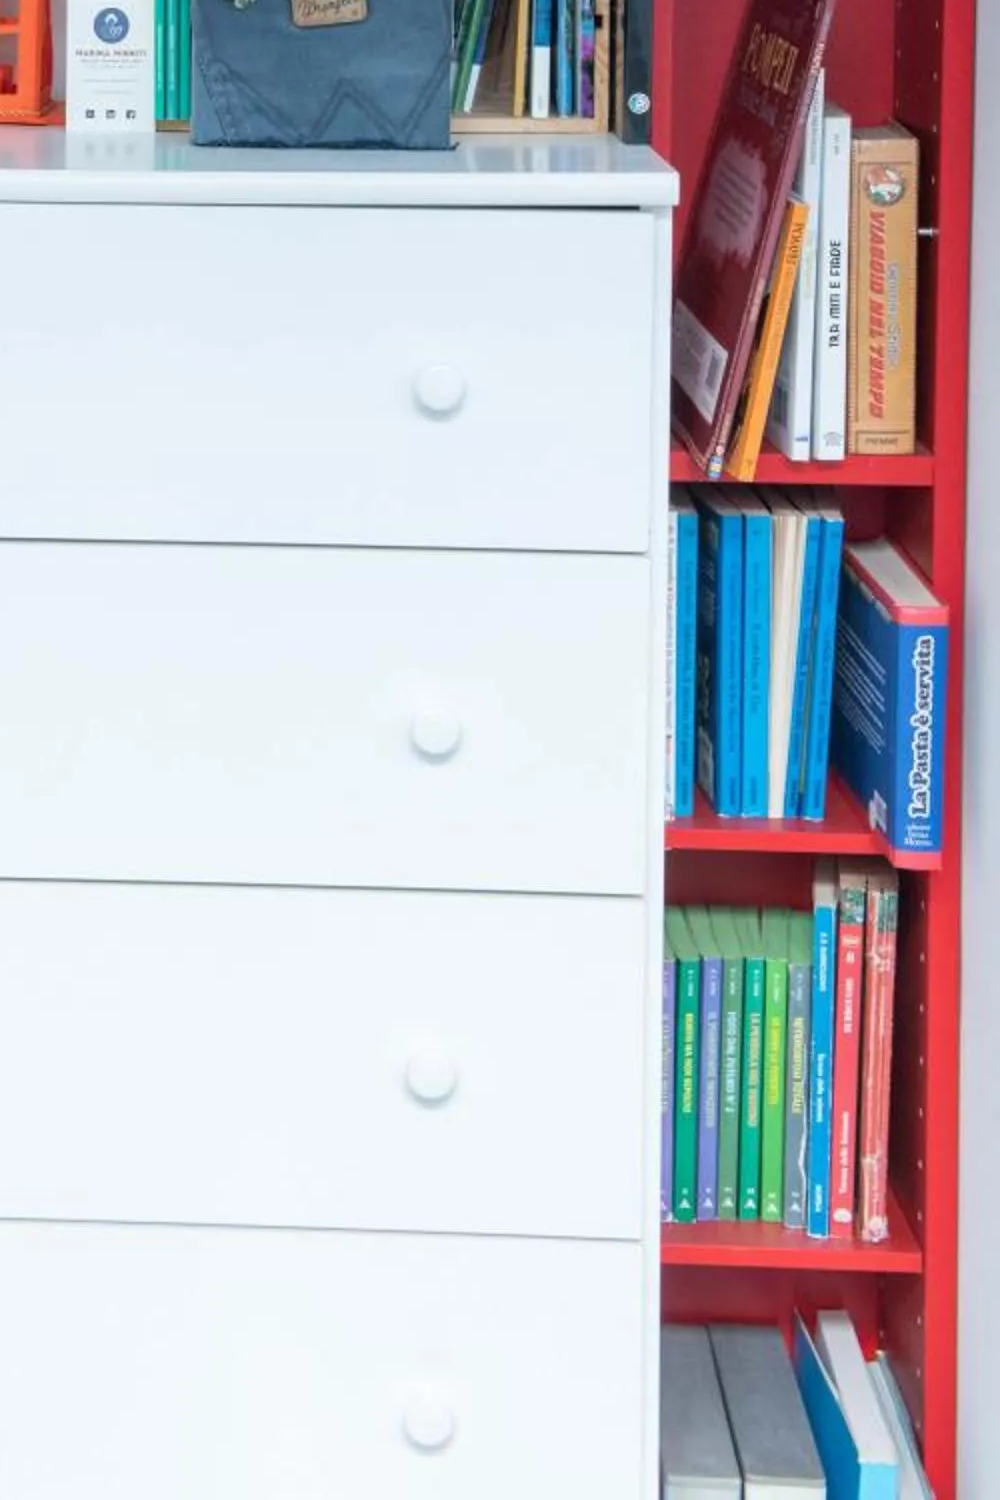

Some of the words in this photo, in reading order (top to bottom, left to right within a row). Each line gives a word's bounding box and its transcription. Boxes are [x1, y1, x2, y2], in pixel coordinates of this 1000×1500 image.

[829, 280, 841, 290] E
[869, 299, 886, 339] NEL
[869, 342, 885, 419] TEMPO
[914, 637, 932, 711] servita
[912, 712, 930, 727] è
[911, 730, 929, 786] Pasta
[911, 791, 928, 816] La
